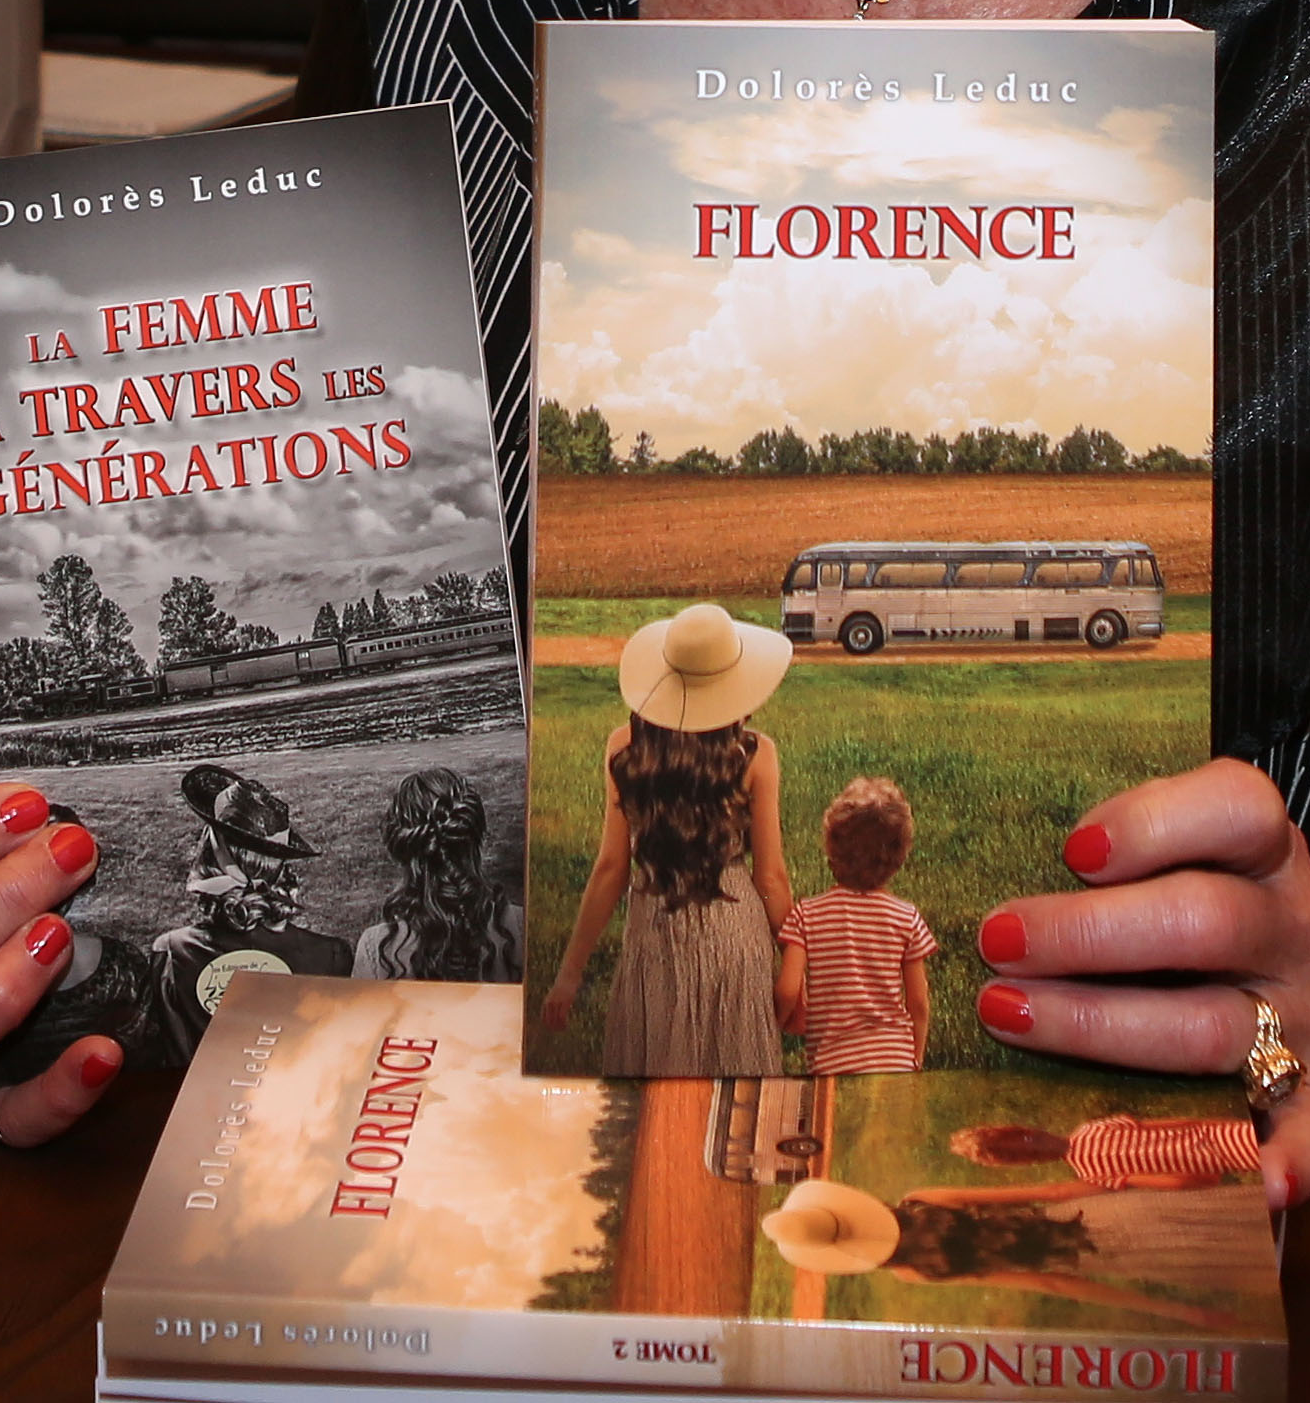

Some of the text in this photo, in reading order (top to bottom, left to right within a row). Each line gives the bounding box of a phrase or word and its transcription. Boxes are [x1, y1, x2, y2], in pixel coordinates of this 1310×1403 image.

[695, 69, 1079, 104] Dolorès Leduc
[190, 165, 324, 203] Leduc
[692, 203, 1076, 261] FLORENCE
[27, 280, 319, 365] LA FEMME
[19, 357, 303, 439] TRAVERS
[322, 365, 387, 403] LES
[185, 1021, 284, 1212] Dolorès Leduc
[329, 1034, 440, 1221] FLORENCE
[154, 1315, 430, 1355] Dolorès Leduc
[611, 1338, 717, 1366] TOME 2
[900, 1336, 1237, 1394] FLORENCE
